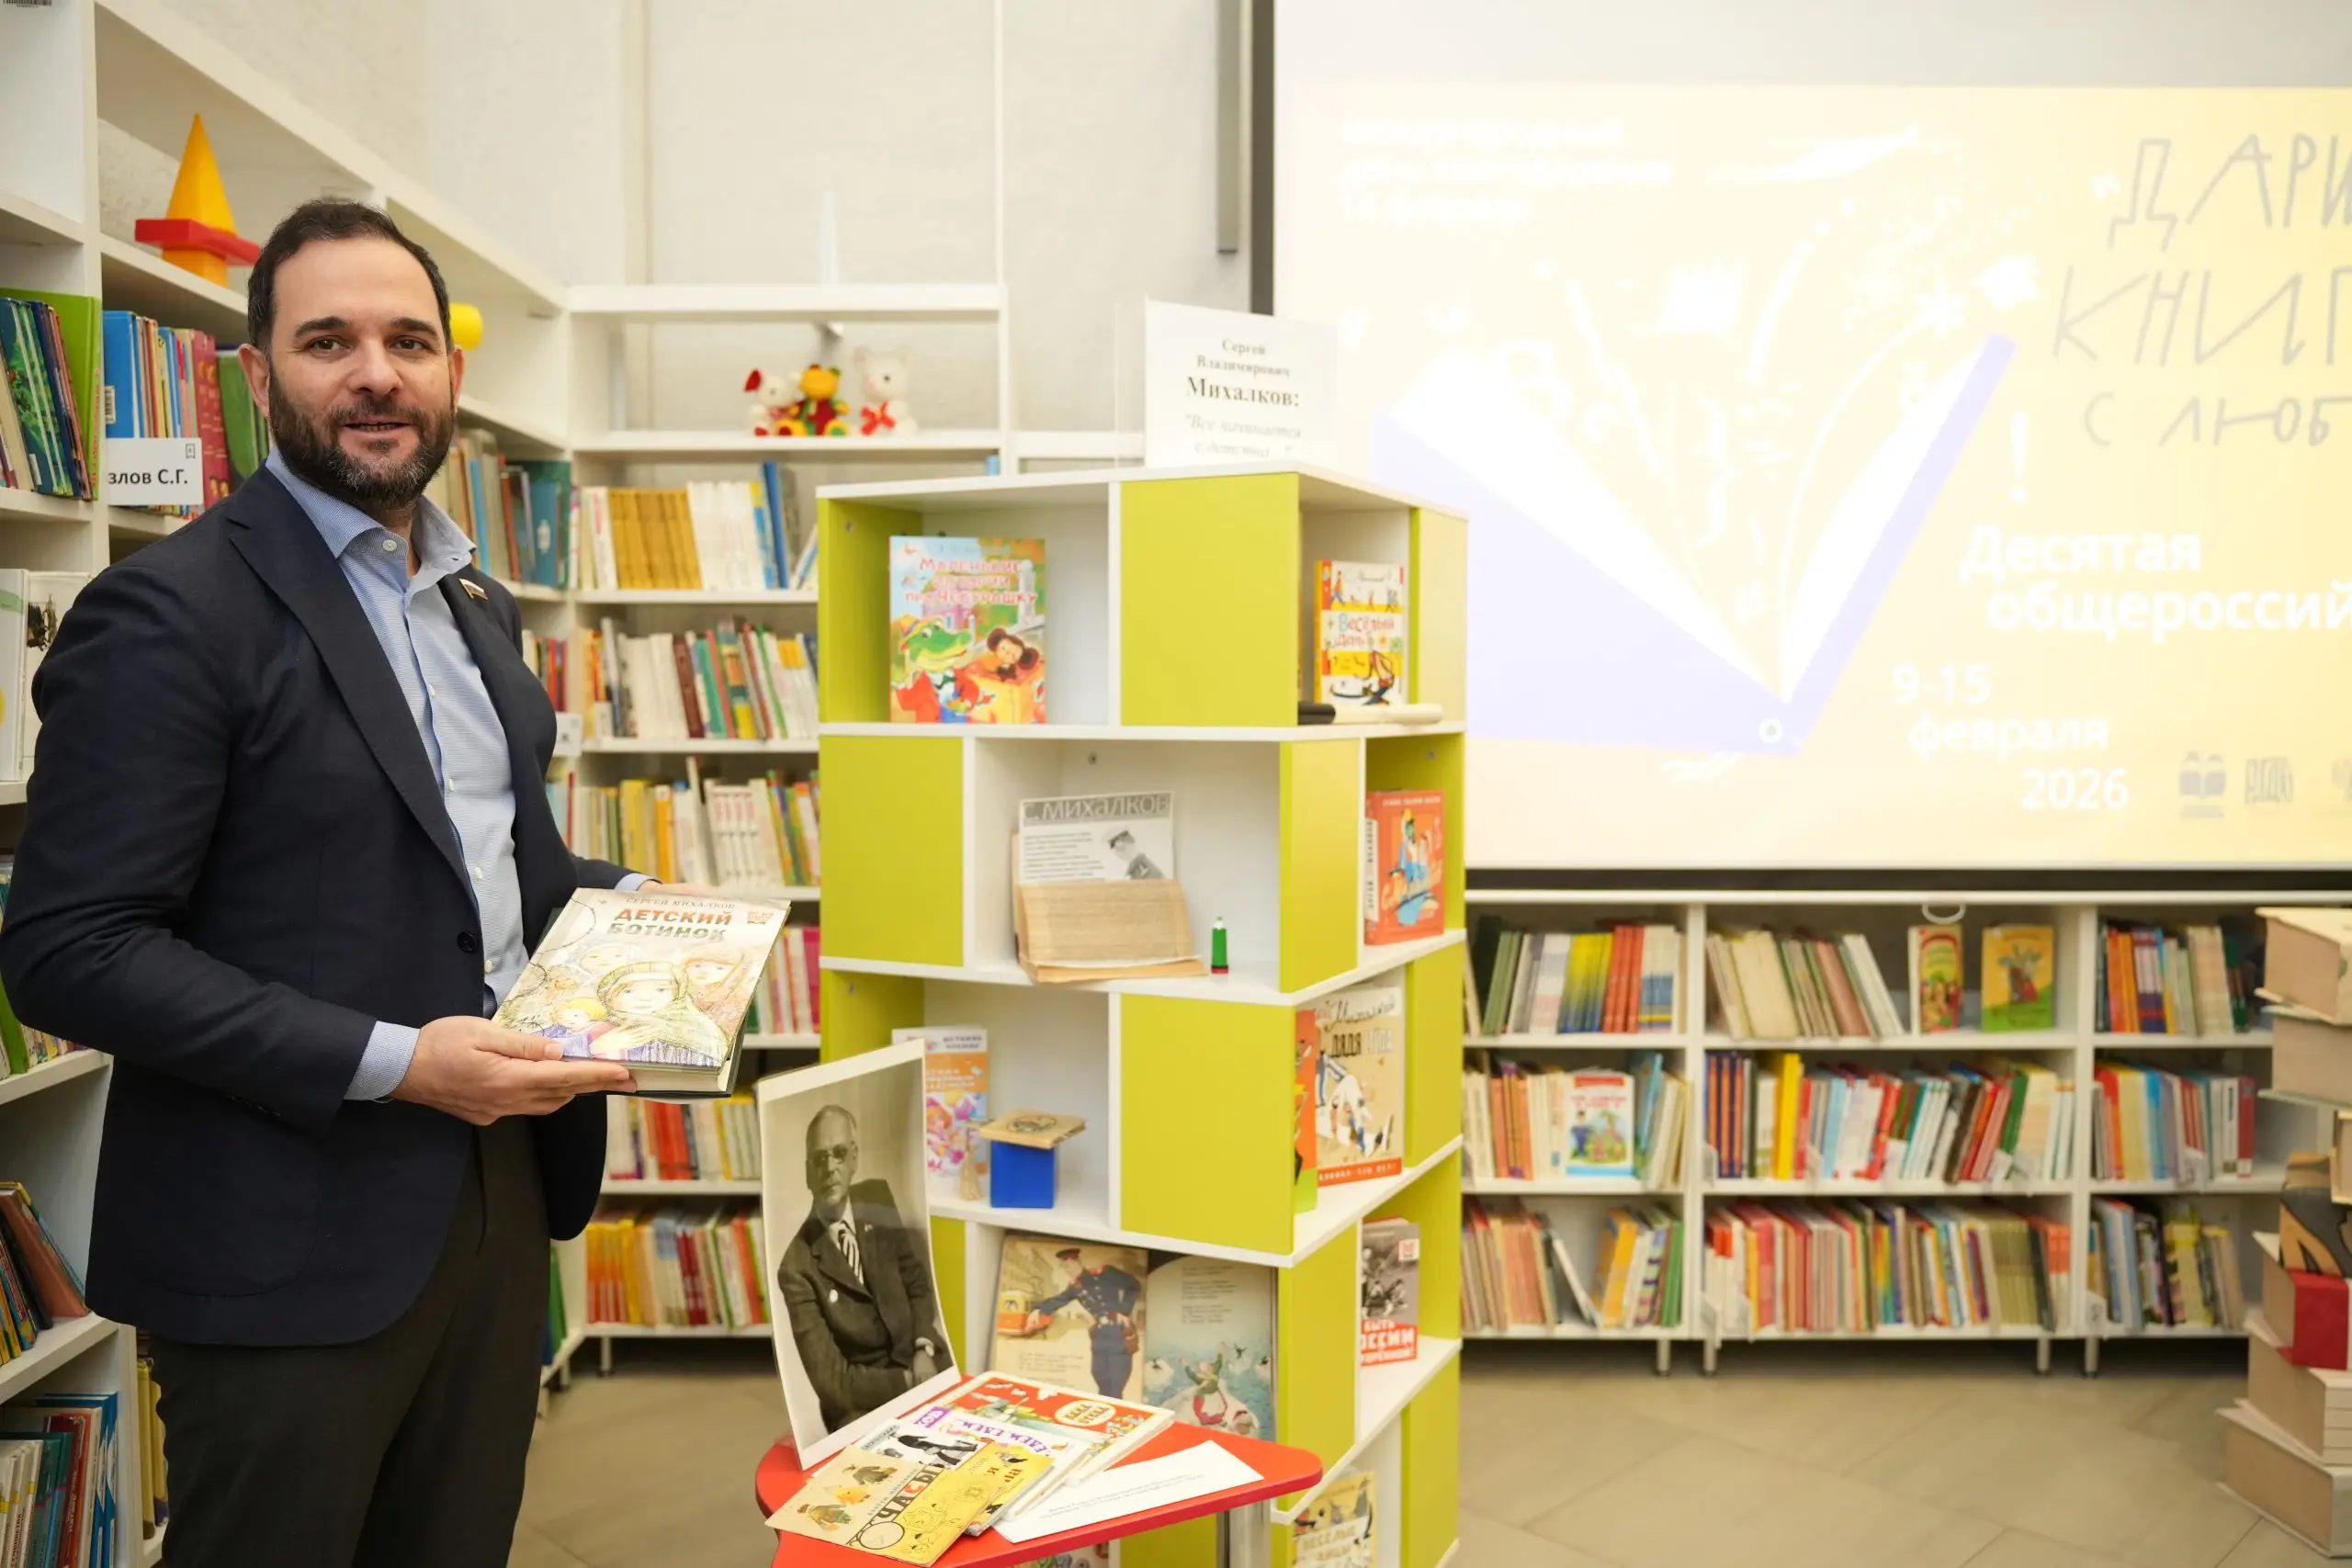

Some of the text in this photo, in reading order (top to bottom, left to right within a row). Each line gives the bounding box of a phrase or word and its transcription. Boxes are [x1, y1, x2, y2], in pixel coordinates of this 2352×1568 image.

[1186, 376, 1300, 408] Михалков:
[157, 468, 188, 485] С.Г.
[1958, 523, 2200, 586] Десятая
[1986, 576, 2352, 645] общероссий
[1892, 661, 1993, 705] 9-15
[1907, 712, 2109, 762] февраля
[2019, 766, 2130, 811] 2026
[606, 922, 727, 942] БОТИНОК
[614, 908, 734, 926] ДЕТСКИЙ
[875, 1466, 944, 1520] ЧАСЫ
